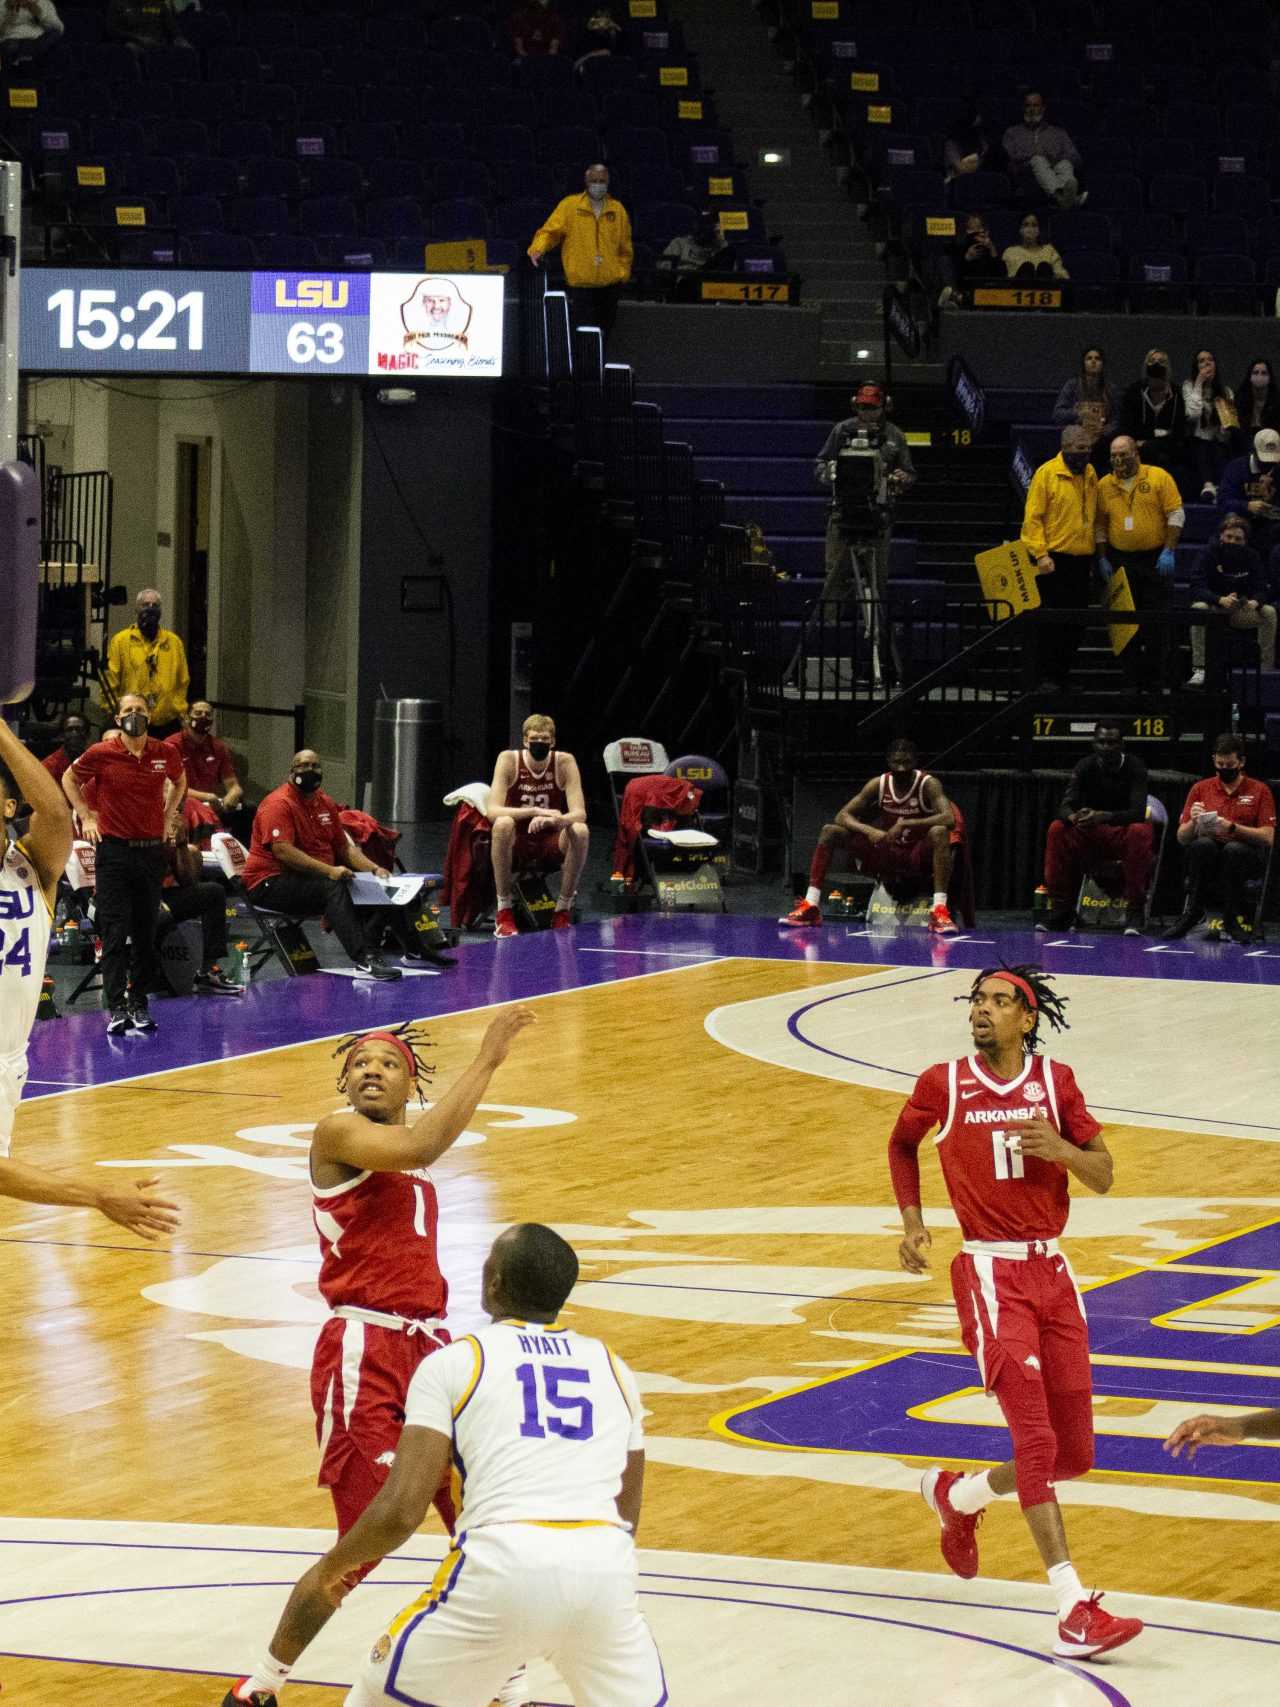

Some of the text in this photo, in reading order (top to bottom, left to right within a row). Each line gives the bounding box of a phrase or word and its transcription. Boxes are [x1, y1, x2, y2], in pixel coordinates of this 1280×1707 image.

[275, 279, 349, 308] LSU
[739, 285, 781, 299] 117
[1011, 291, 1052, 305] 118
[47, 289, 204, 350] 15:21
[286, 322, 344, 364] 63
[1133, 718, 1165, 736] 118
[674, 767, 713, 779] LSU
[517, 1334, 572, 1356] HYATT
[515, 1363, 594, 1441] 15
